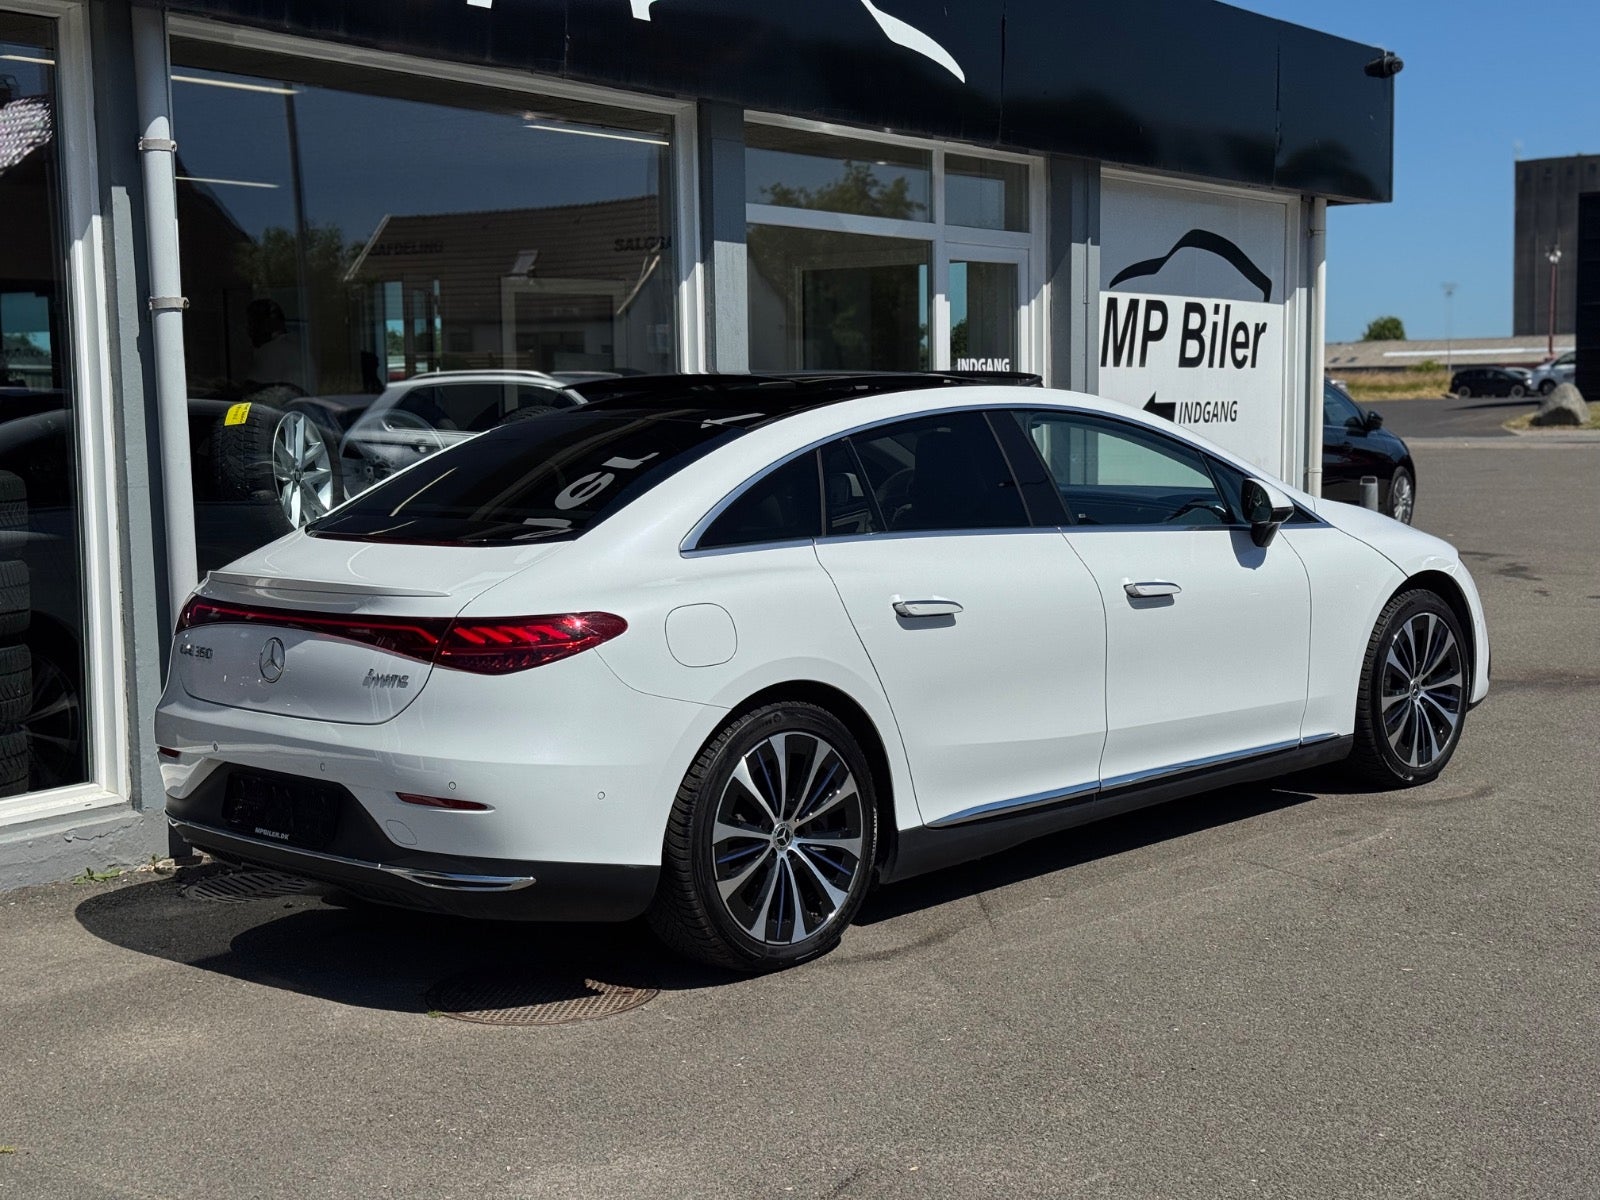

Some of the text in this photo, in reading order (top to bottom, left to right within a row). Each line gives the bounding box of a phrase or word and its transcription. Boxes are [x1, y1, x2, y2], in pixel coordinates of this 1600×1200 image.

[1100, 297, 1268, 369] MP Biler
[957, 358, 1010, 372] INDGANG
[1178, 401, 1238, 424] INDGANG
